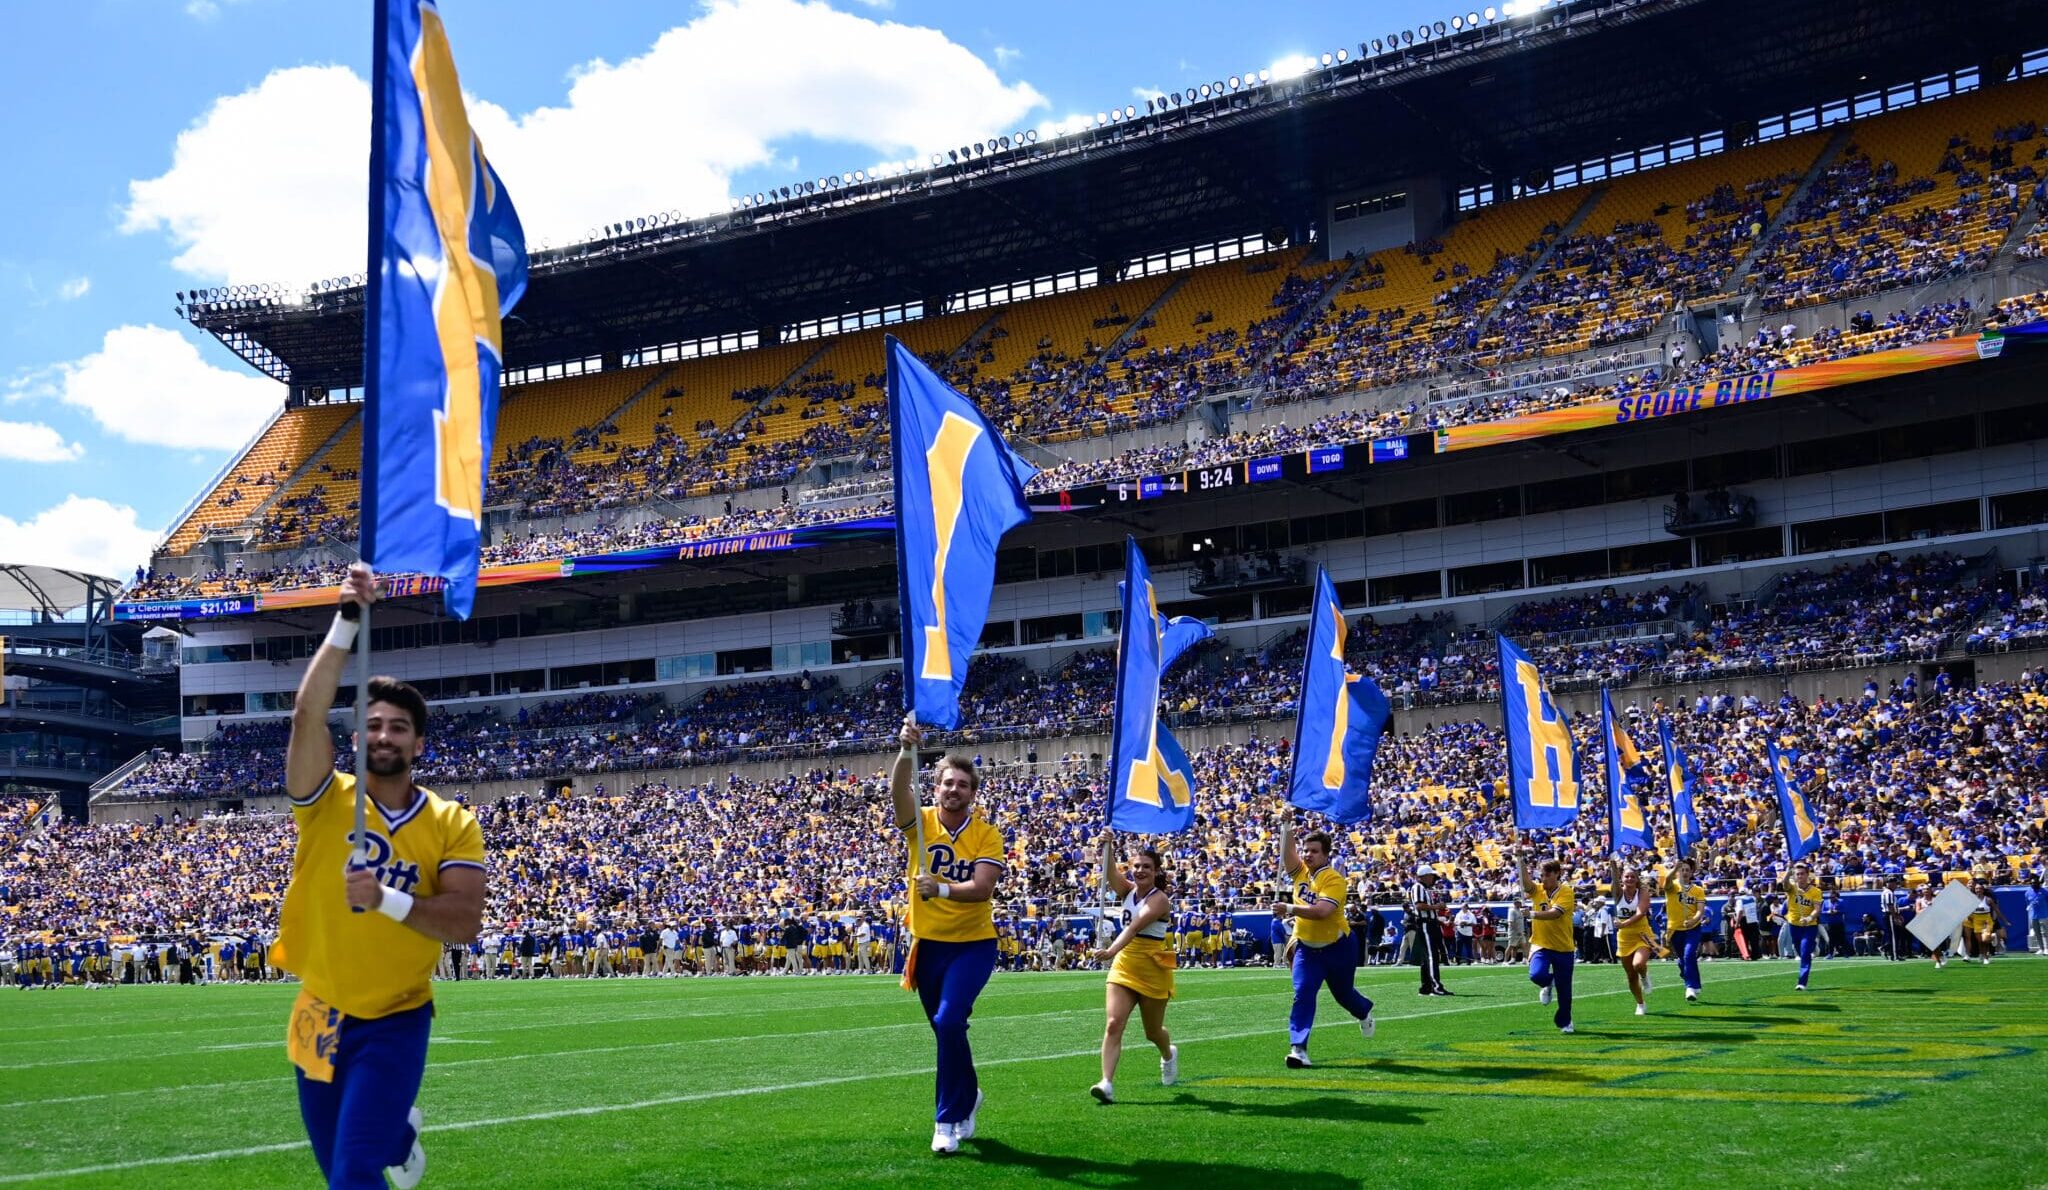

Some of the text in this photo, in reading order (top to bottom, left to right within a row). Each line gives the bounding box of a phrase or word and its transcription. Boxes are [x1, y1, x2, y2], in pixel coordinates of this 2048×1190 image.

[1615, 371, 1776, 423] SCORE BIG!
[1386, 439, 1404, 450] BALL
[1321, 453, 1340, 465] TO GO
[1393, 448, 1405, 458] ON
[1256, 463, 1279, 476] DOWN
[1169, 477, 1177, 491] 2
[1200, 467, 1234, 490] 9:24
[1118, 483, 1128, 501] 6
[679, 533, 793, 560] PA LOTTERY ONLINE
[385, 575, 446, 598] ORE BIG
[138, 604, 182, 612] Clearview
[200, 600, 241, 615] $21,120
[926, 843, 976, 884] Pitt
